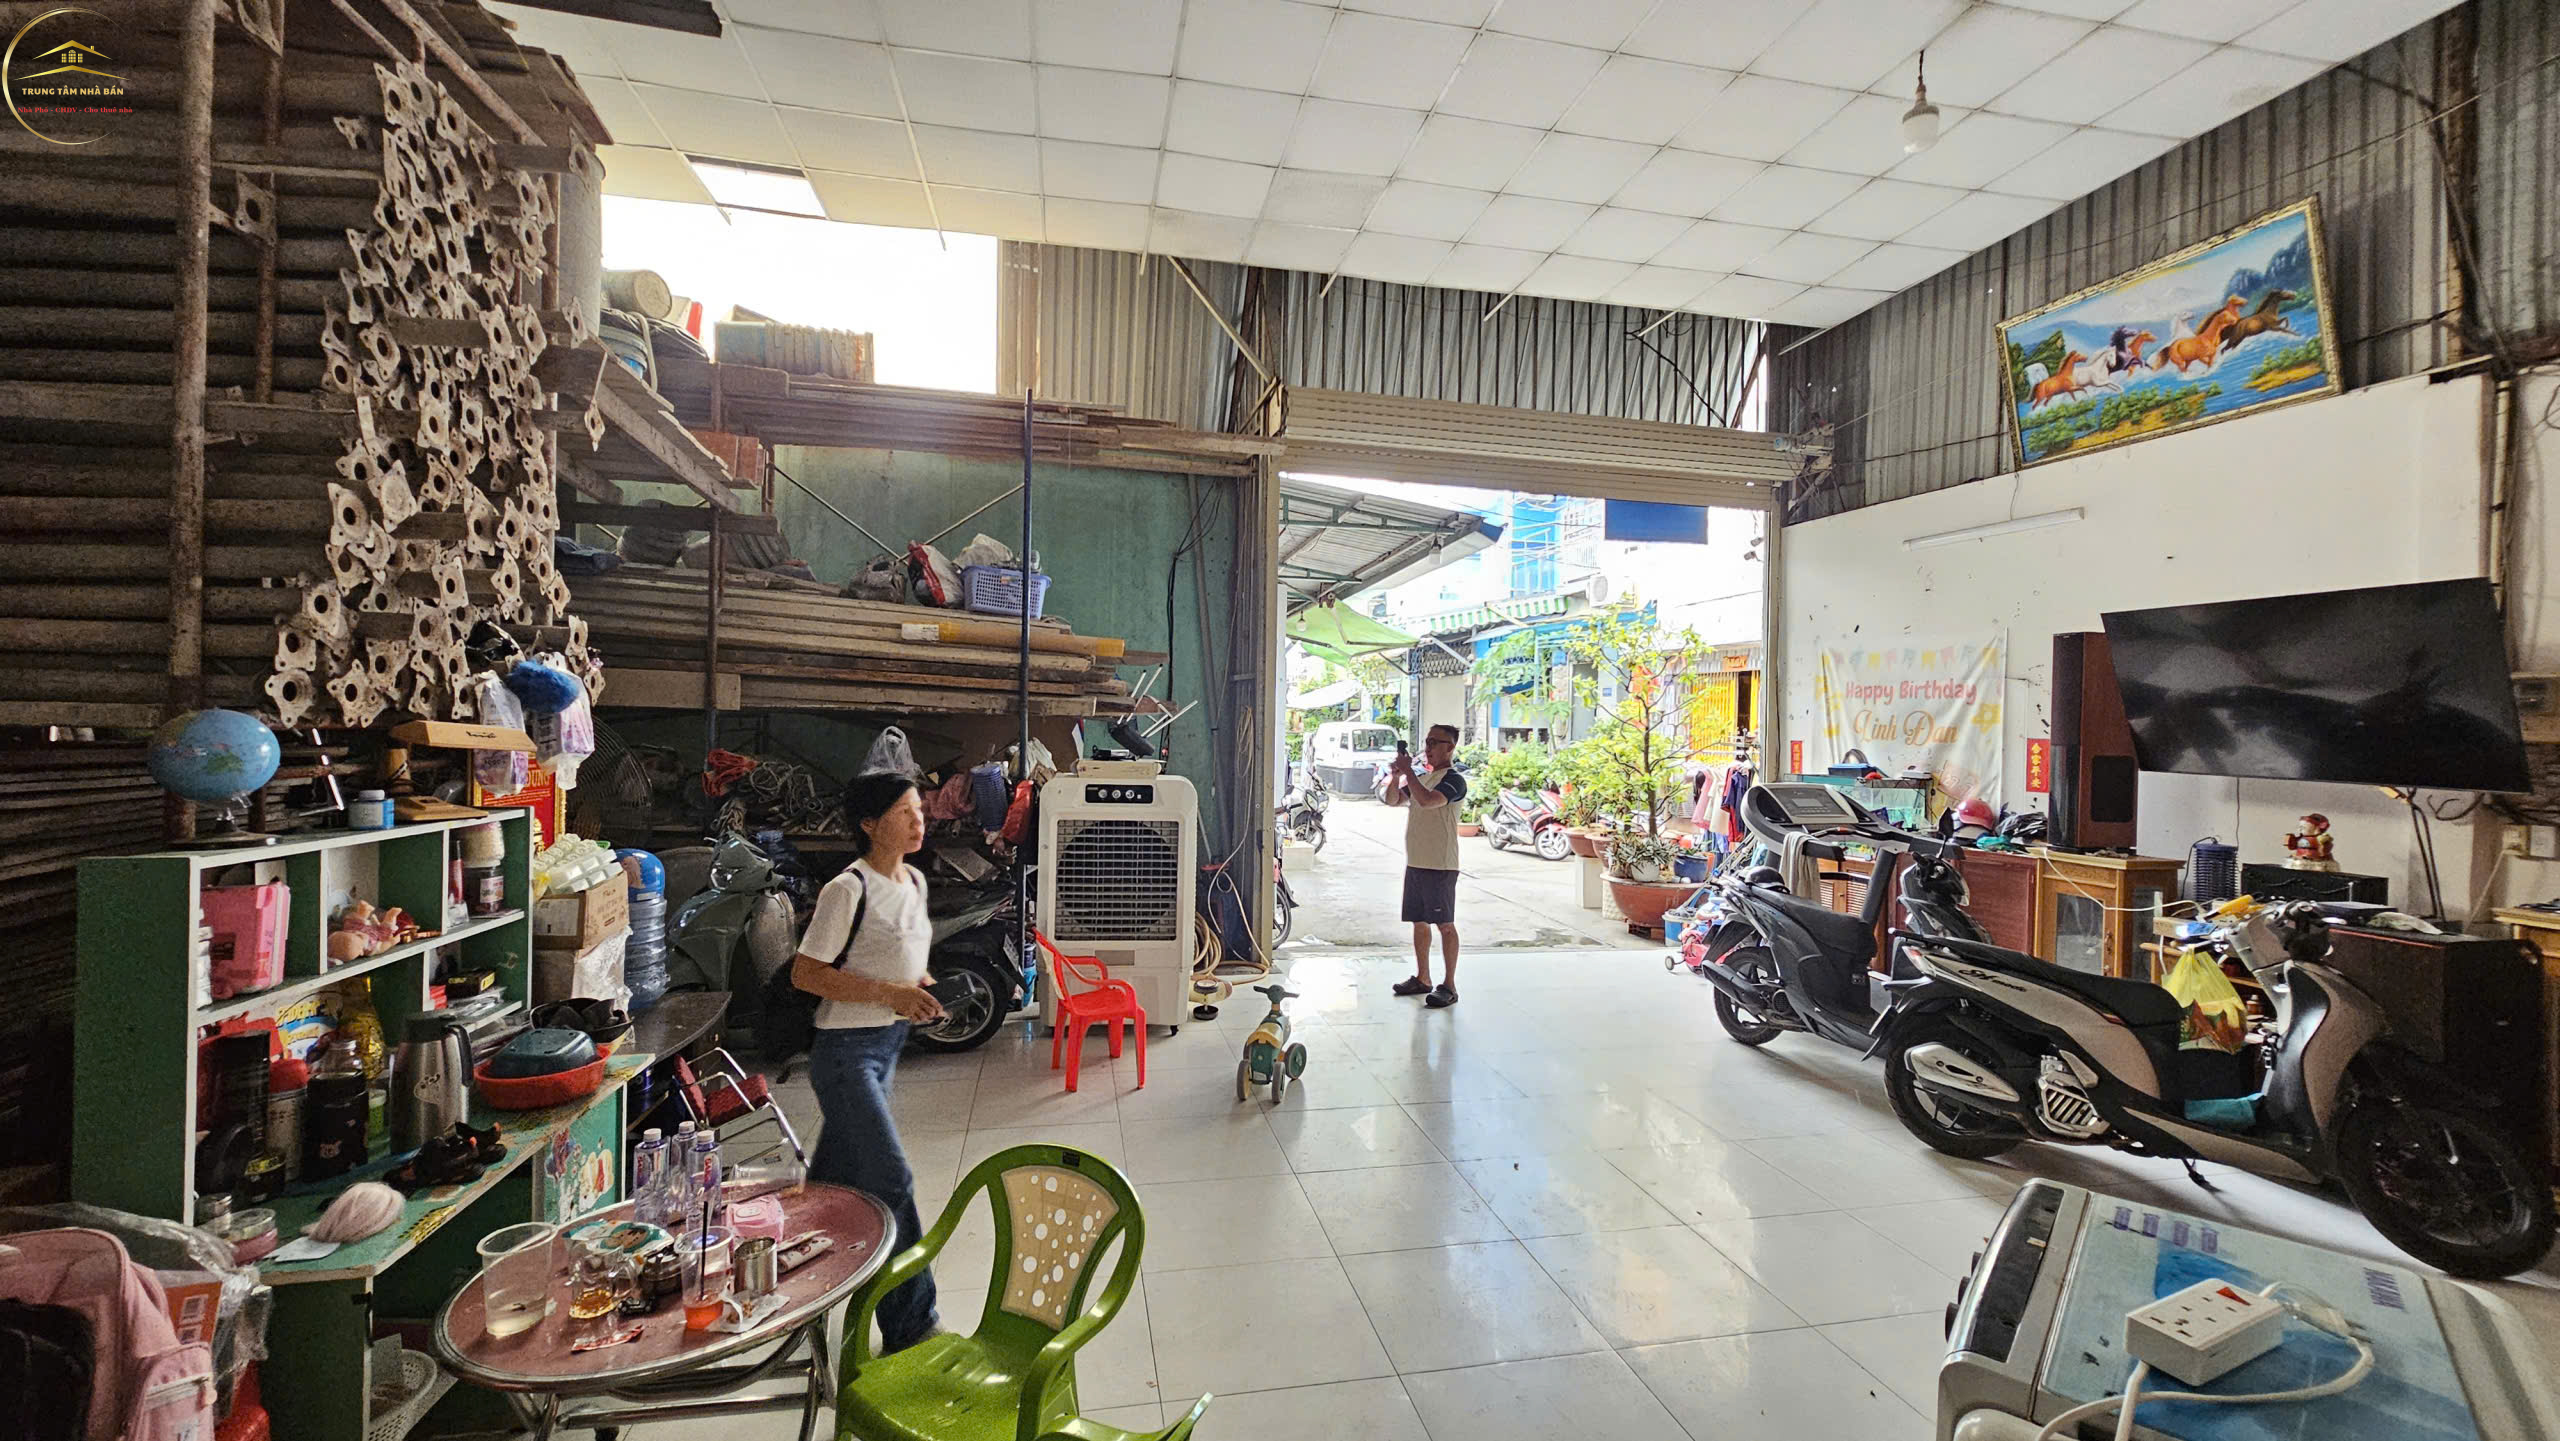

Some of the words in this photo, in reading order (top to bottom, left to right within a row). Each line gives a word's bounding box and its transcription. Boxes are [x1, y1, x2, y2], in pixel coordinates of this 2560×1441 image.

[1845, 681, 1895, 705] Happy
[1899, 678, 1977, 705] Birthday
[1853, 709, 1897, 742] Linh
